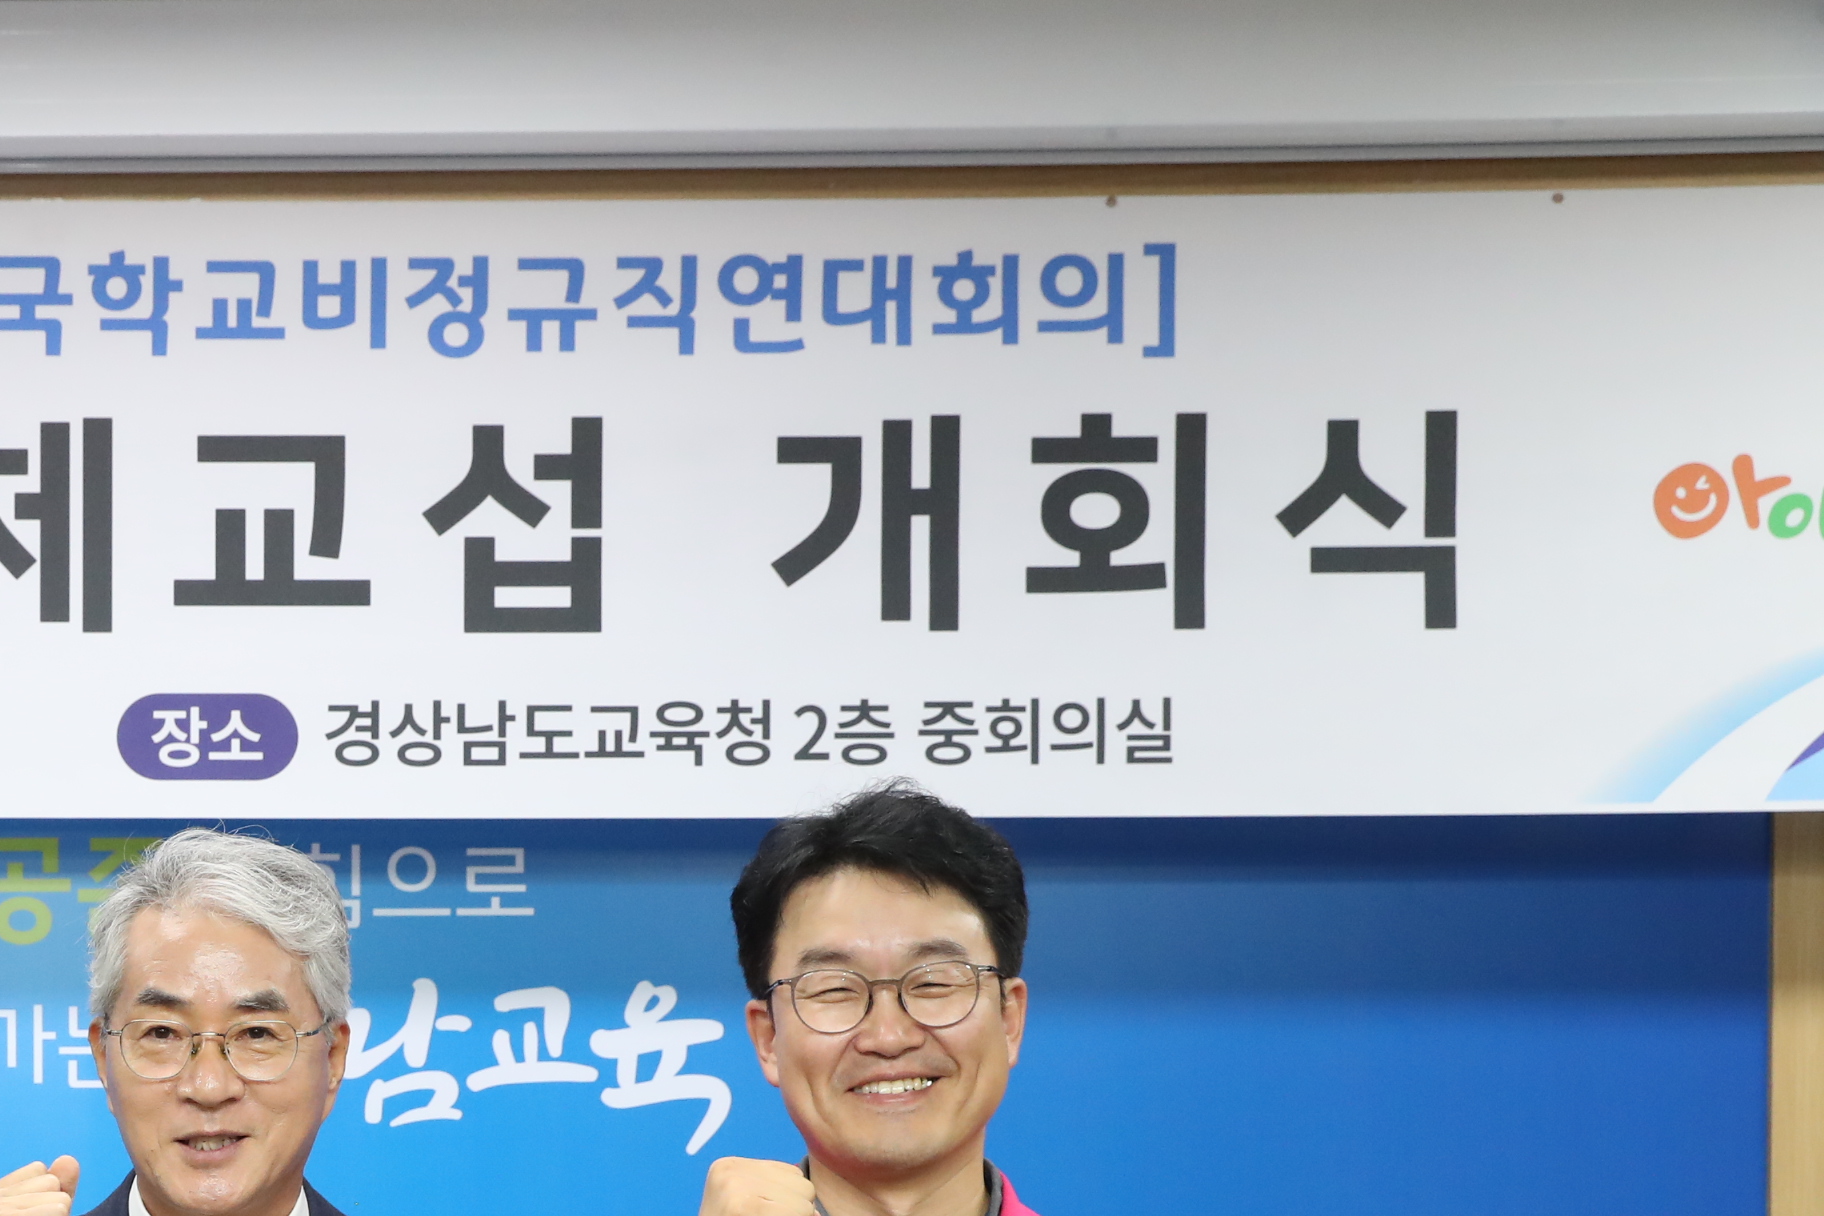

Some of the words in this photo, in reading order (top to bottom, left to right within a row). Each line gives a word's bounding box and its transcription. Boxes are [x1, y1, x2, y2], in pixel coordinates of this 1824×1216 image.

[771, 410, 1458, 632] 개회식
[150, 706, 264, 768] 장소
[324, 699, 772, 767] 경상남도교육청
[793, 699, 896, 766] 2층
[917, 697, 1174, 766] 중회의실
